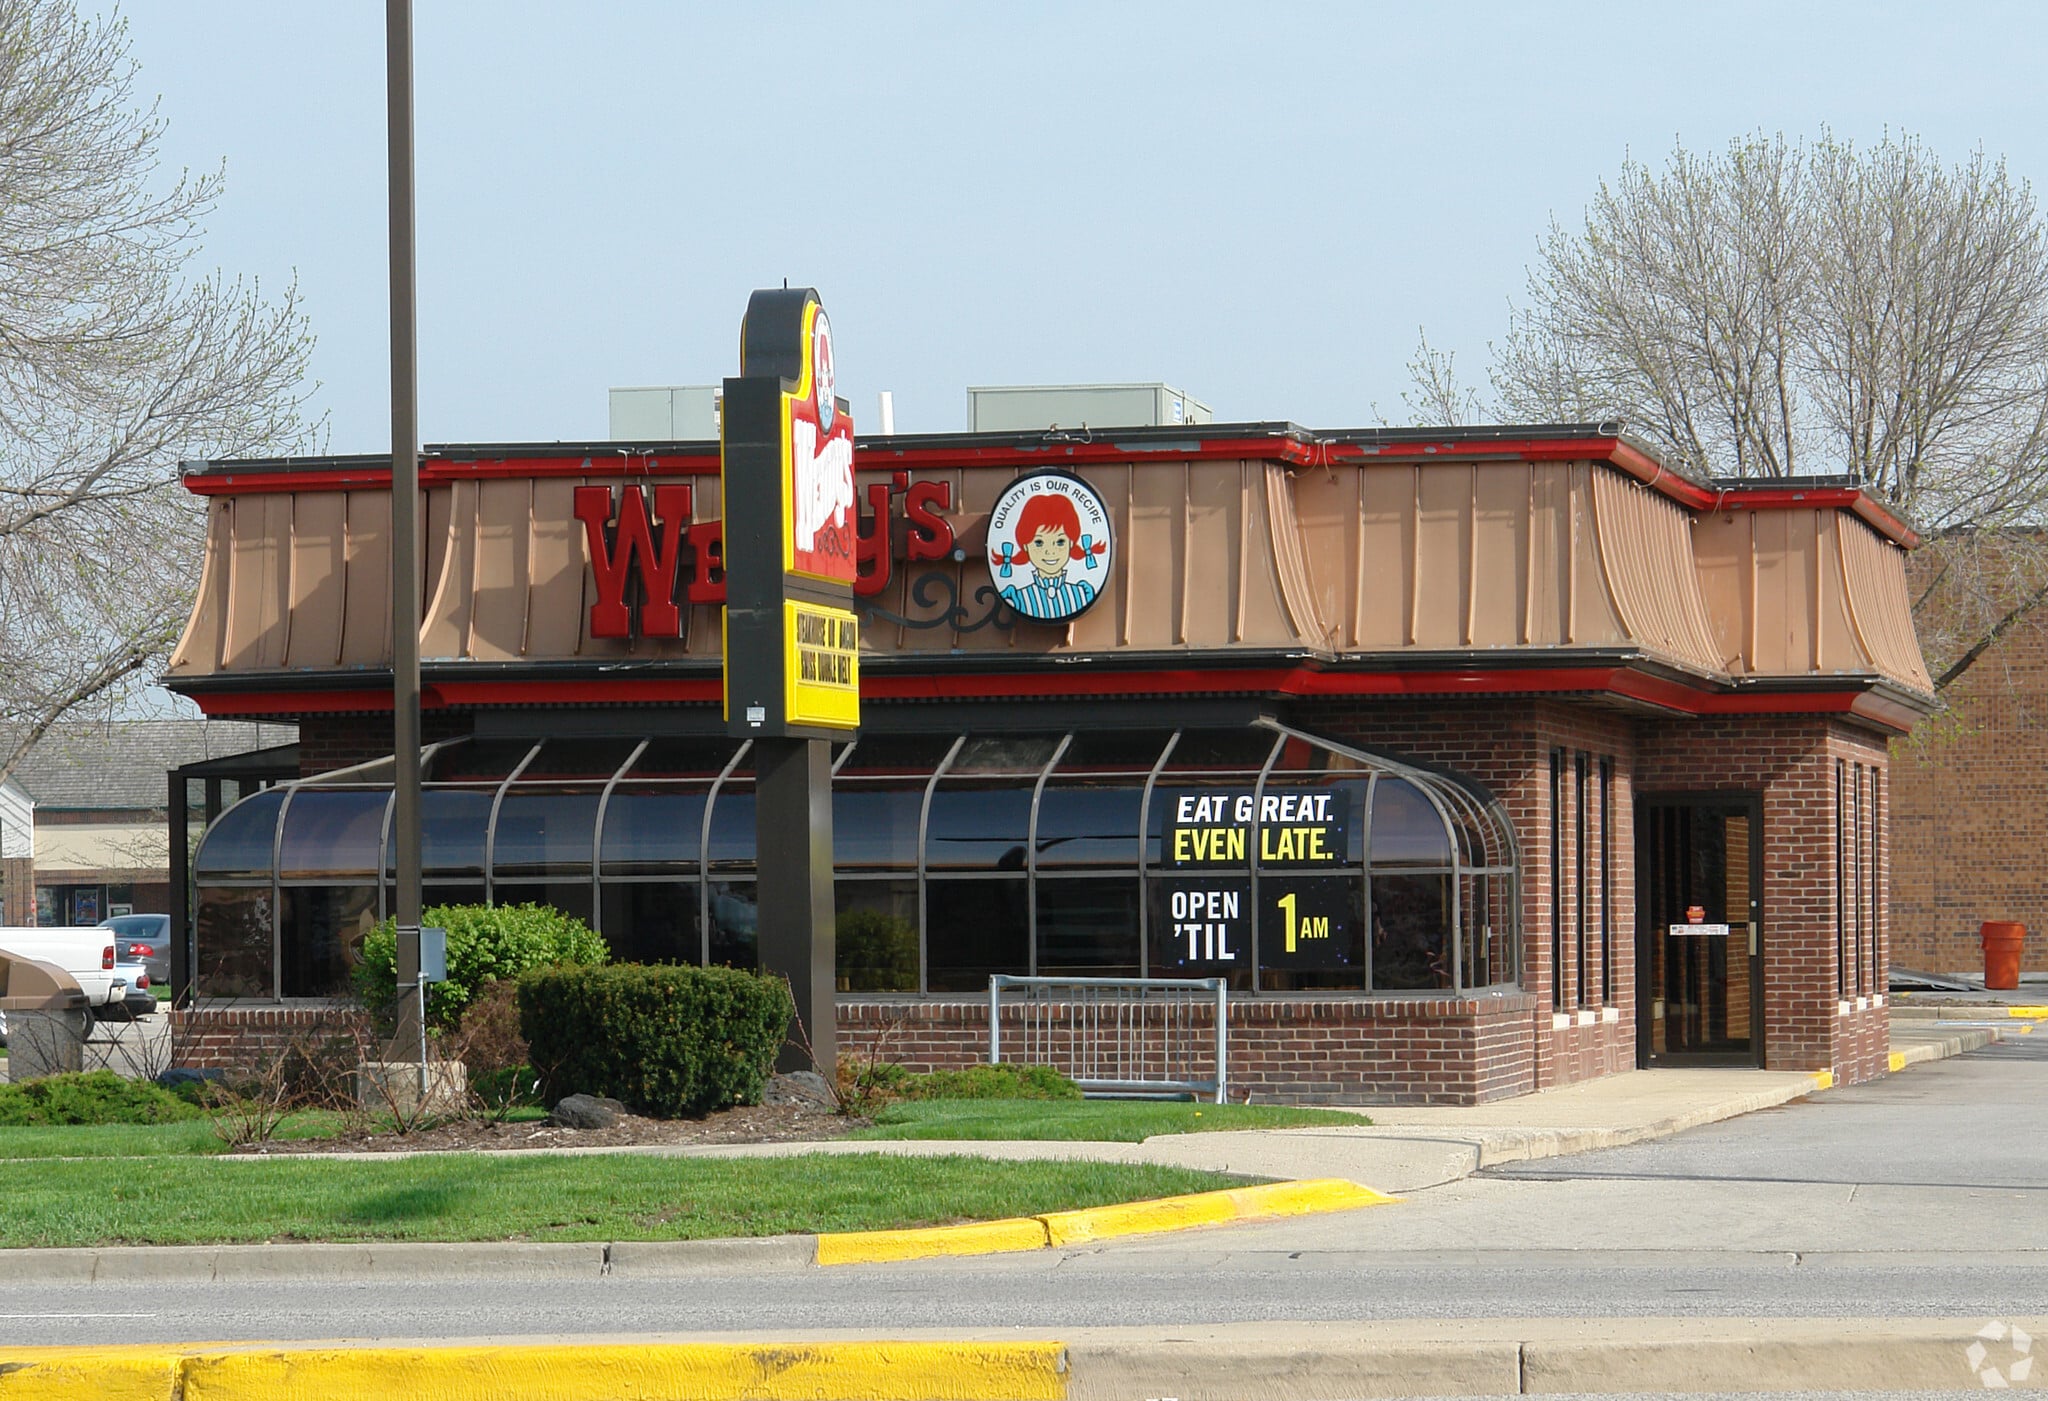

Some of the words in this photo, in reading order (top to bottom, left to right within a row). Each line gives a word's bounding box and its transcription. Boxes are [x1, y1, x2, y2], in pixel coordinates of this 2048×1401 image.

[995, 488, 1025, 529] QUALITY
[1030, 481, 1041, 492] IS
[1046, 480, 1069, 493] OUR
[1072, 488, 1102, 525] RECIPE
[1176, 796, 1228, 823] EAT
[1234, 795, 1333, 822] GREAT.
[1174, 828, 1245, 861] EVEN
[1261, 827, 1333, 861] LATE.
[1171, 891, 1239, 920] OPEN
[1277, 893, 1296, 952] 1
[1300, 917, 1329, 939] AM
[1174, 923, 1235, 961] 'TIL
